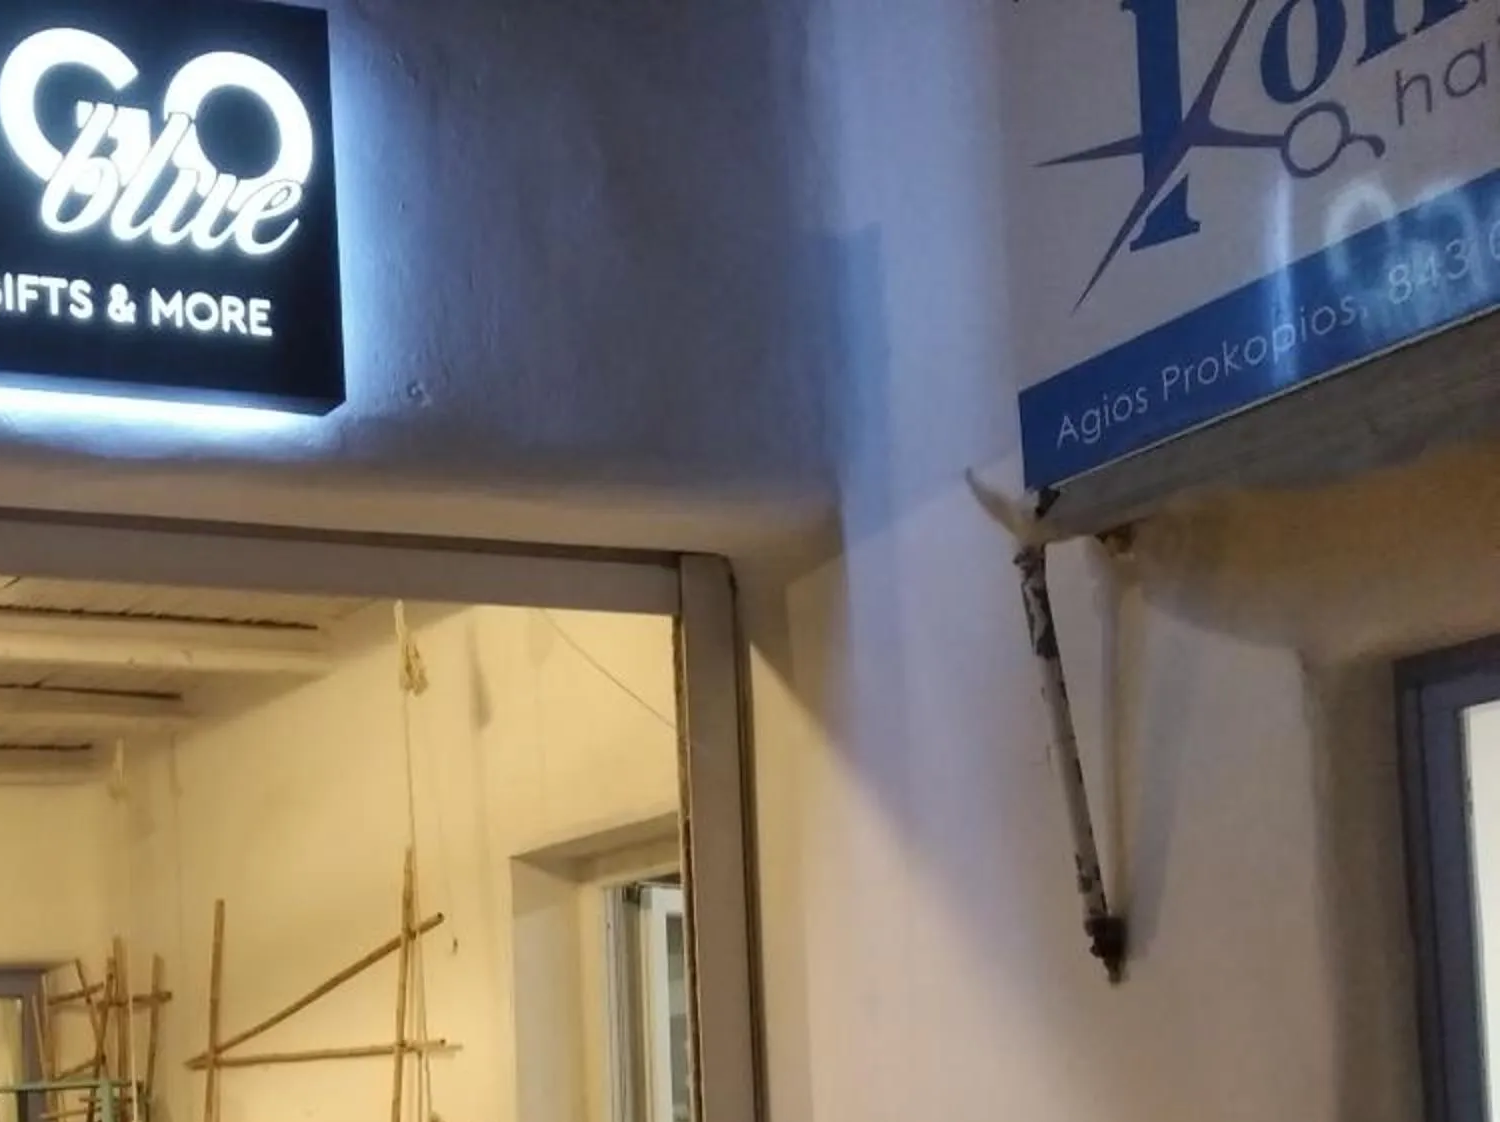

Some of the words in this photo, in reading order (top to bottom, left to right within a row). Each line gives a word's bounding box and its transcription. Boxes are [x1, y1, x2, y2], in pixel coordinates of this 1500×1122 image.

[40, 100, 304, 257] blue
[107, 284, 137, 325] &
[149, 289, 273, 338] MORE
[1056, 382, 1149, 448] Agios
[1161, 293, 1369, 402] Prokopios,
